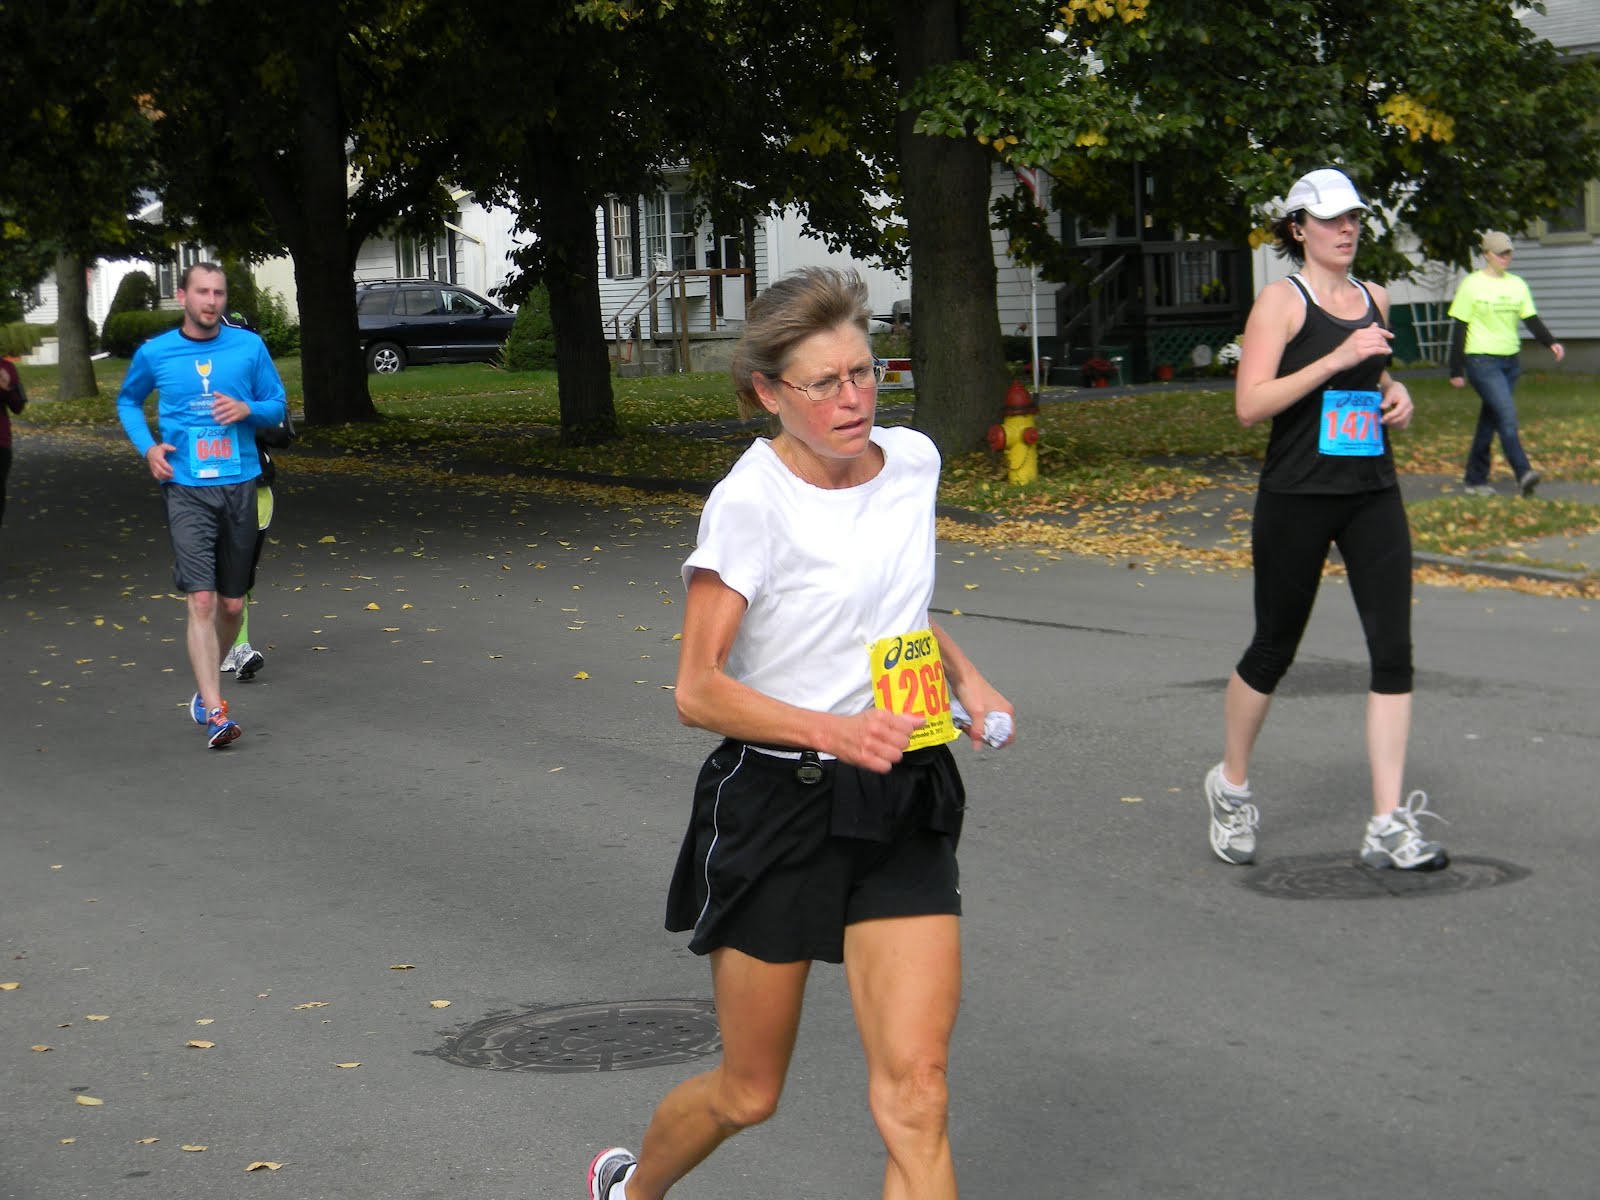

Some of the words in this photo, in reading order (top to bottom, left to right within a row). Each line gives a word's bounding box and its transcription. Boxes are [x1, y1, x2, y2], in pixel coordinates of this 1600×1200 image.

[1326, 411, 1378, 440] 1471
[197, 437, 232, 460] 646
[904, 636, 931, 661] asics
[876, 660, 951, 717] 1262
